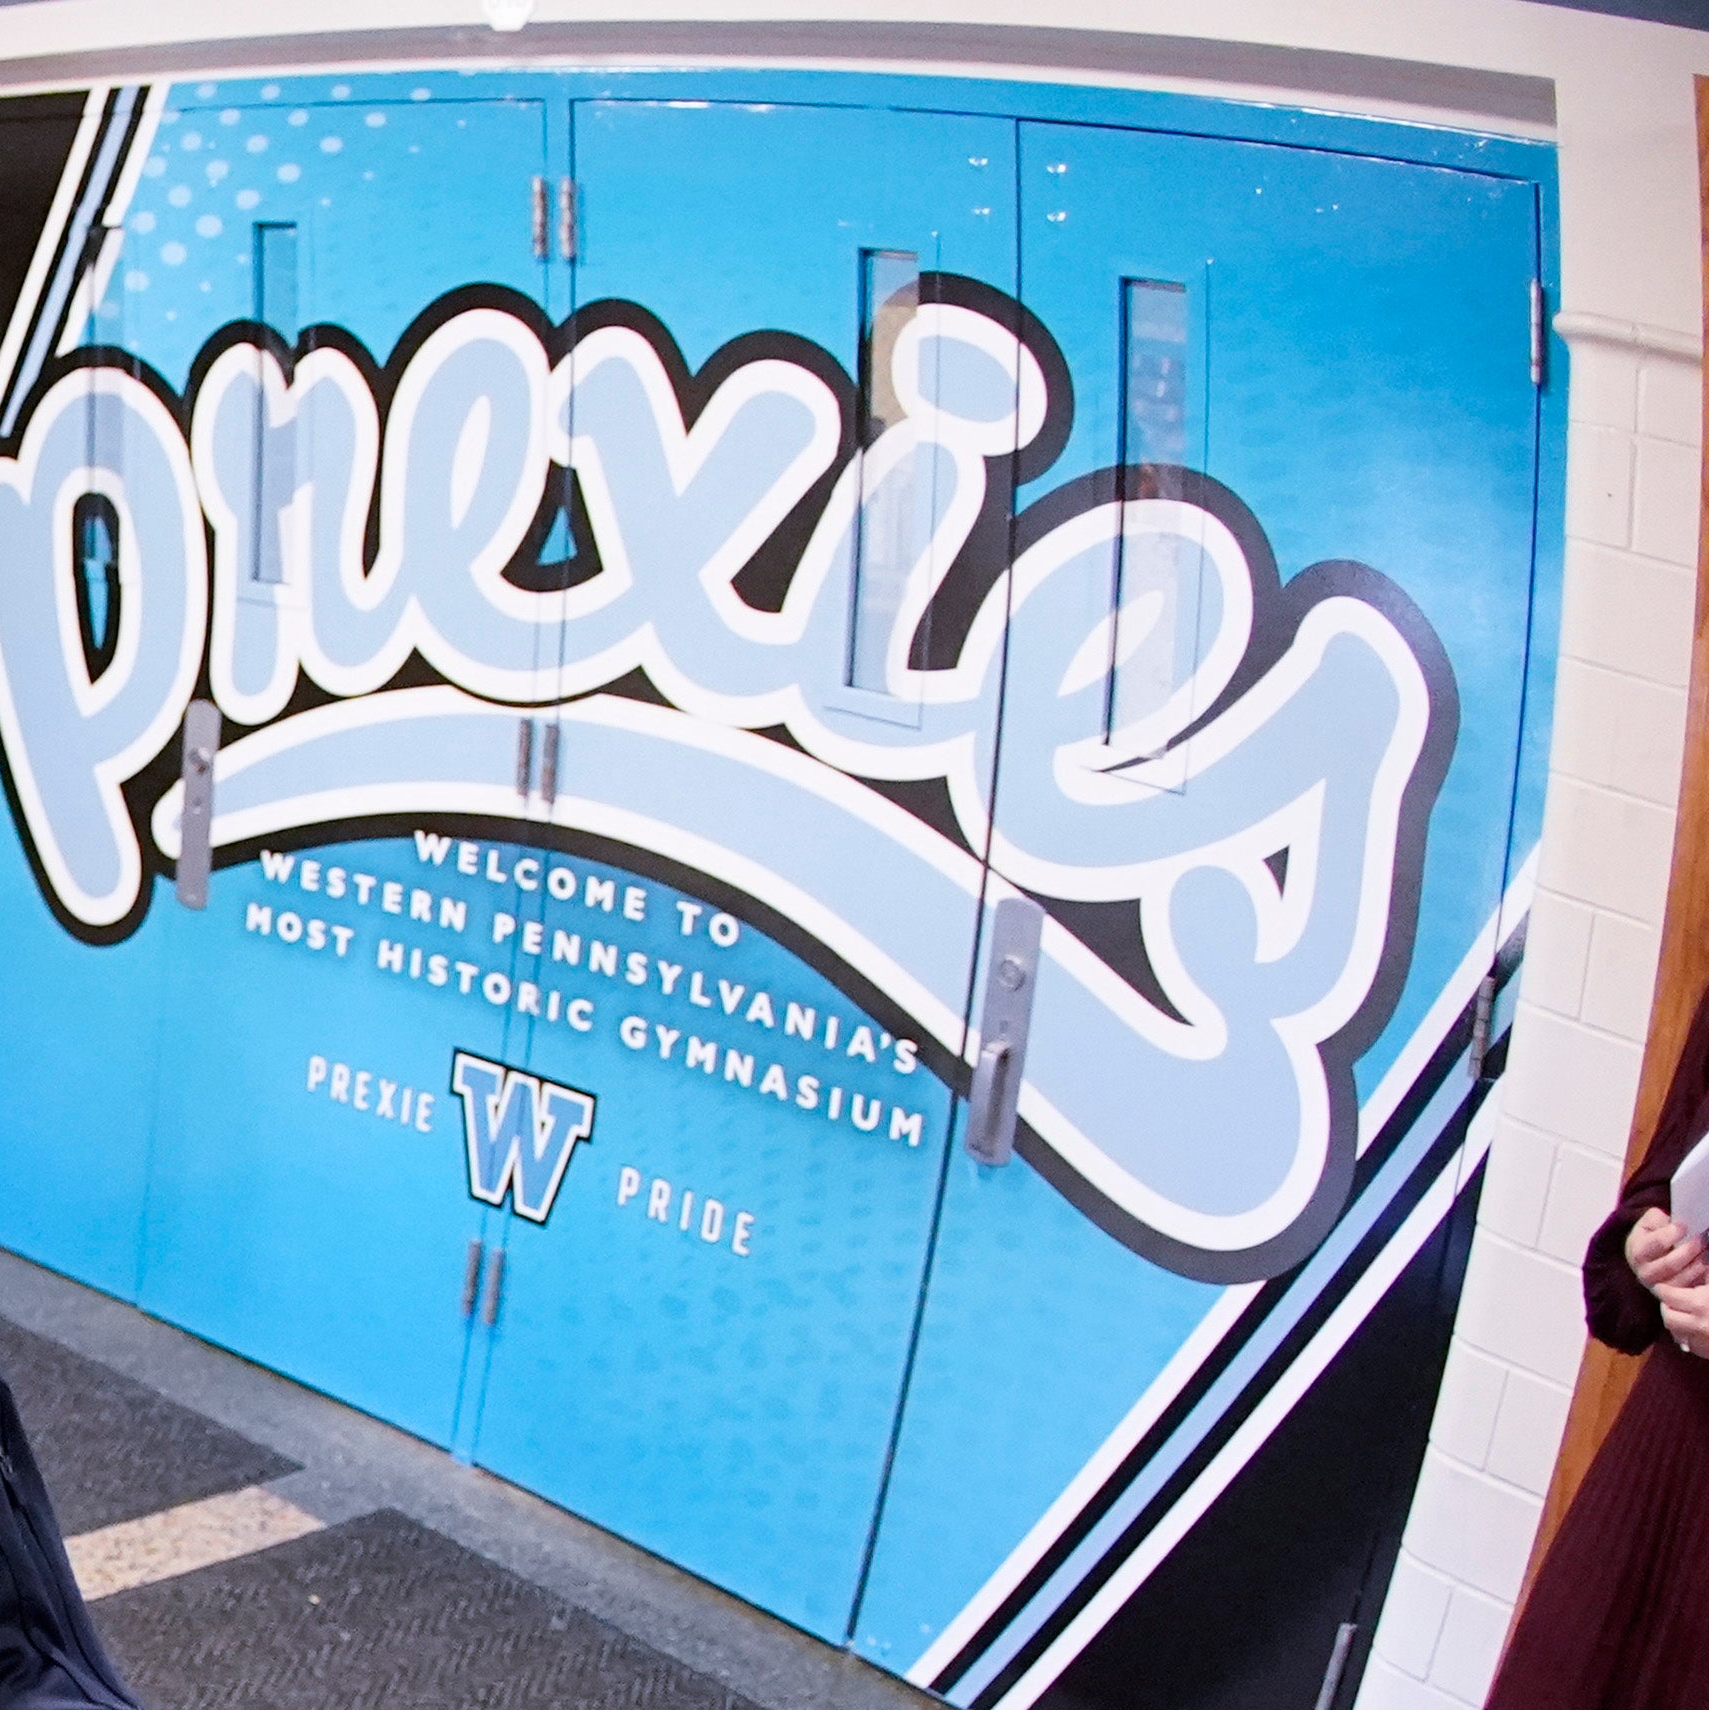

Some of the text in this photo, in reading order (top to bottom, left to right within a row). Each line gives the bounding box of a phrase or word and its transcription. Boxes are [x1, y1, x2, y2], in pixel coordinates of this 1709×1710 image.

[415, 829, 741, 948] WELCOME TO
[246, 903, 923, 1147] MOST HISTORIC GYMNASIUM
[259, 851, 921, 1075] WESTERN PENNSYLVANIA'S
[306, 1054, 437, 1134] PREXIE
[451, 1049, 596, 1224] W
[617, 1167, 755, 1258] PRIDE
